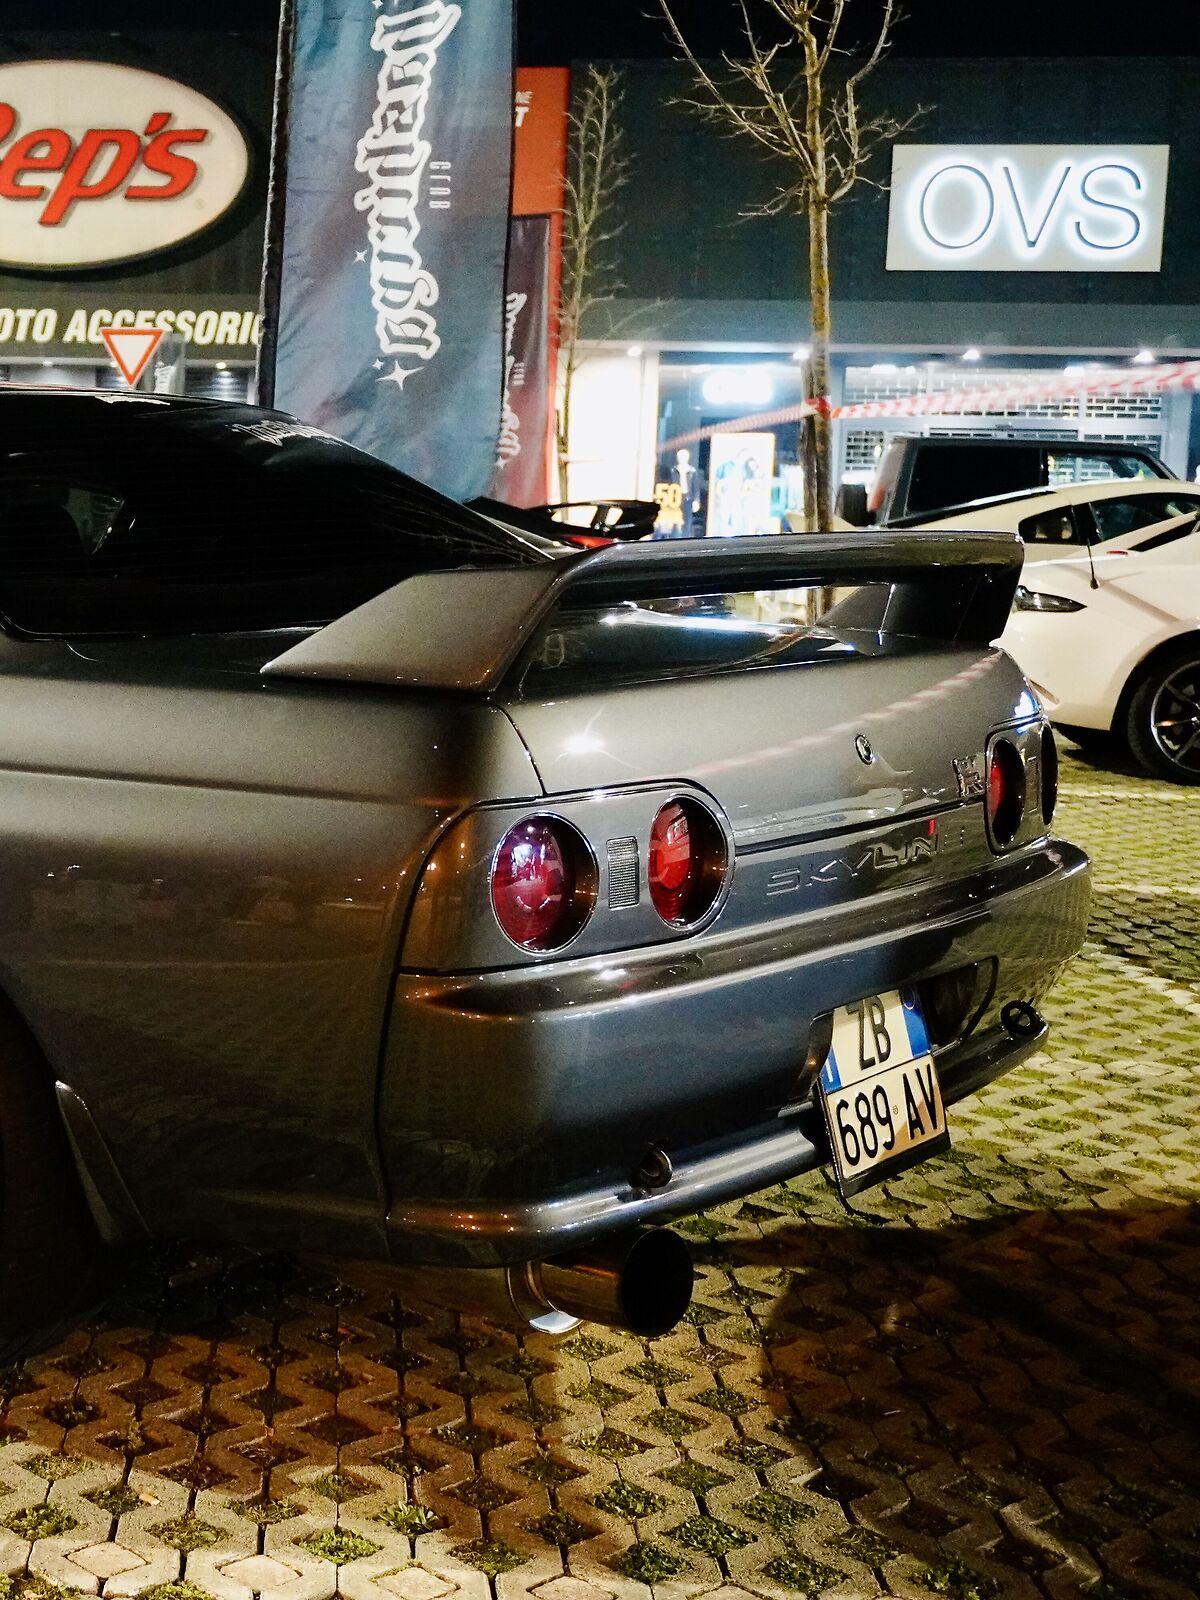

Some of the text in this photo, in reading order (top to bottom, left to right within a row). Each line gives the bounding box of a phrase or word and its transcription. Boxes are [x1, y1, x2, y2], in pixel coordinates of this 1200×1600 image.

[919, 164, 1141, 250] OVS
[845, 995, 892, 1071] ZB
[835, 1063, 938, 1167] 689 AV
